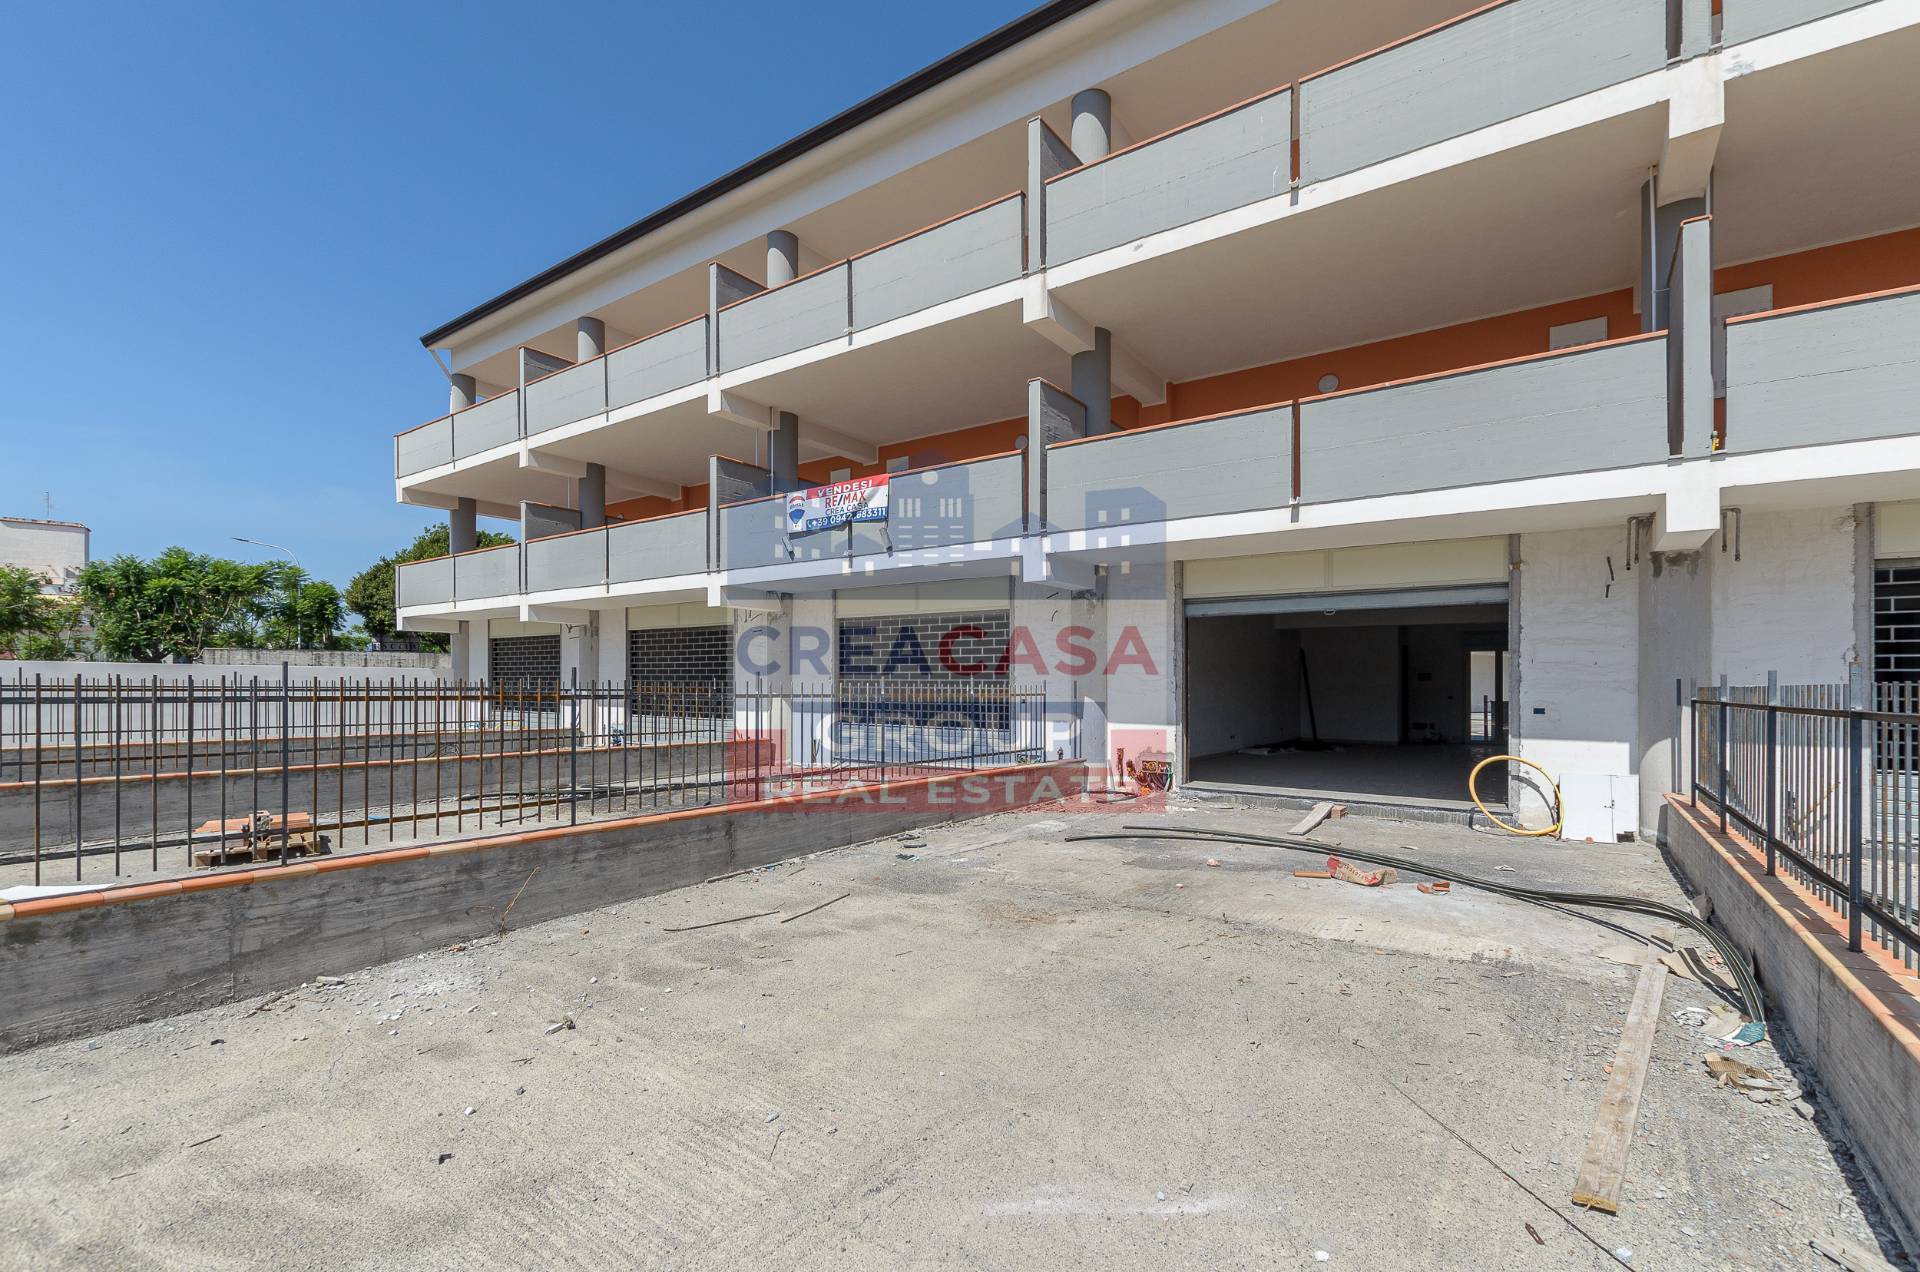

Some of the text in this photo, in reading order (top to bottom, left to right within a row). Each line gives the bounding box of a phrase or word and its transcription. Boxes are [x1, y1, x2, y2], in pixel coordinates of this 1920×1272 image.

[818, 480, 872, 497] VENDESI
[825, 491, 866, 508] RE/MAX
[825, 502, 869, 516] CREA CASA
[812, 517, 828, 527] +39
